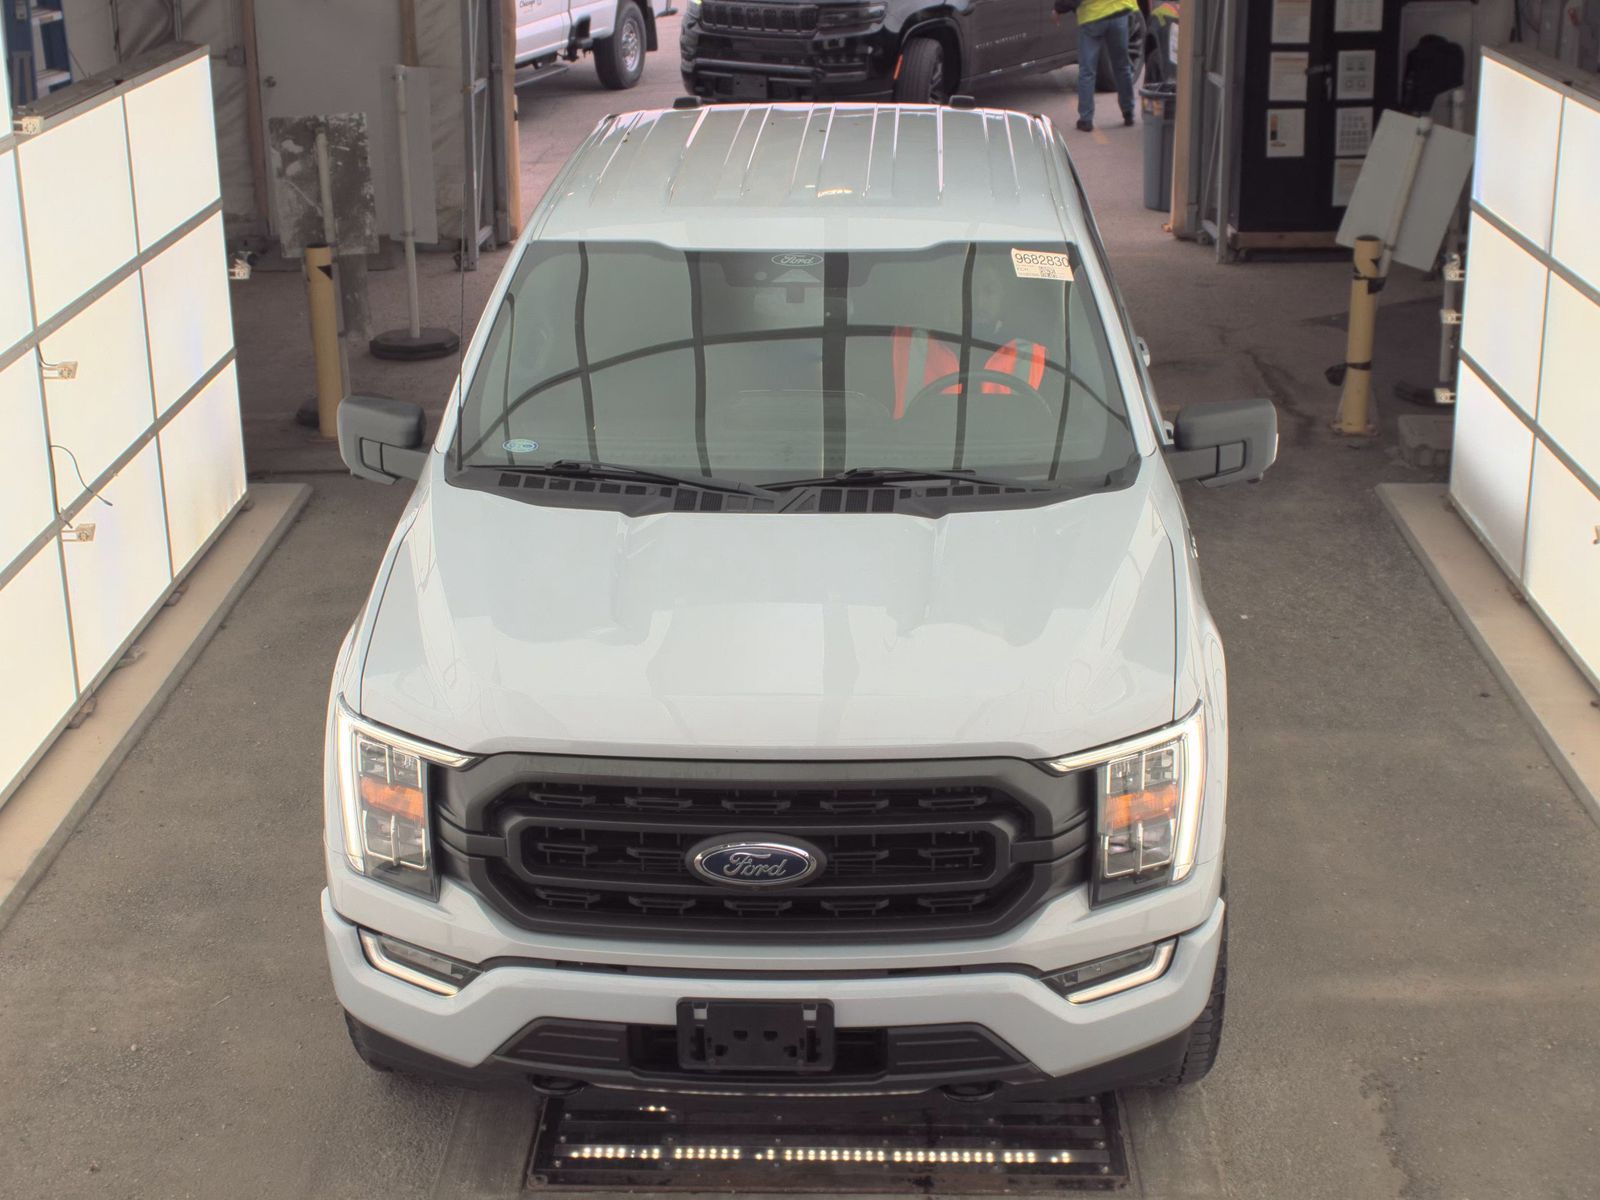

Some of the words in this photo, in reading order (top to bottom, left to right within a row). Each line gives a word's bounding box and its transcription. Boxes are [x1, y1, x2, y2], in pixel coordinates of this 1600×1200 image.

[780, 254, 816, 264] Ford
[1014, 253, 1070, 268] 9682830
[722, 852, 788, 877] Ford
